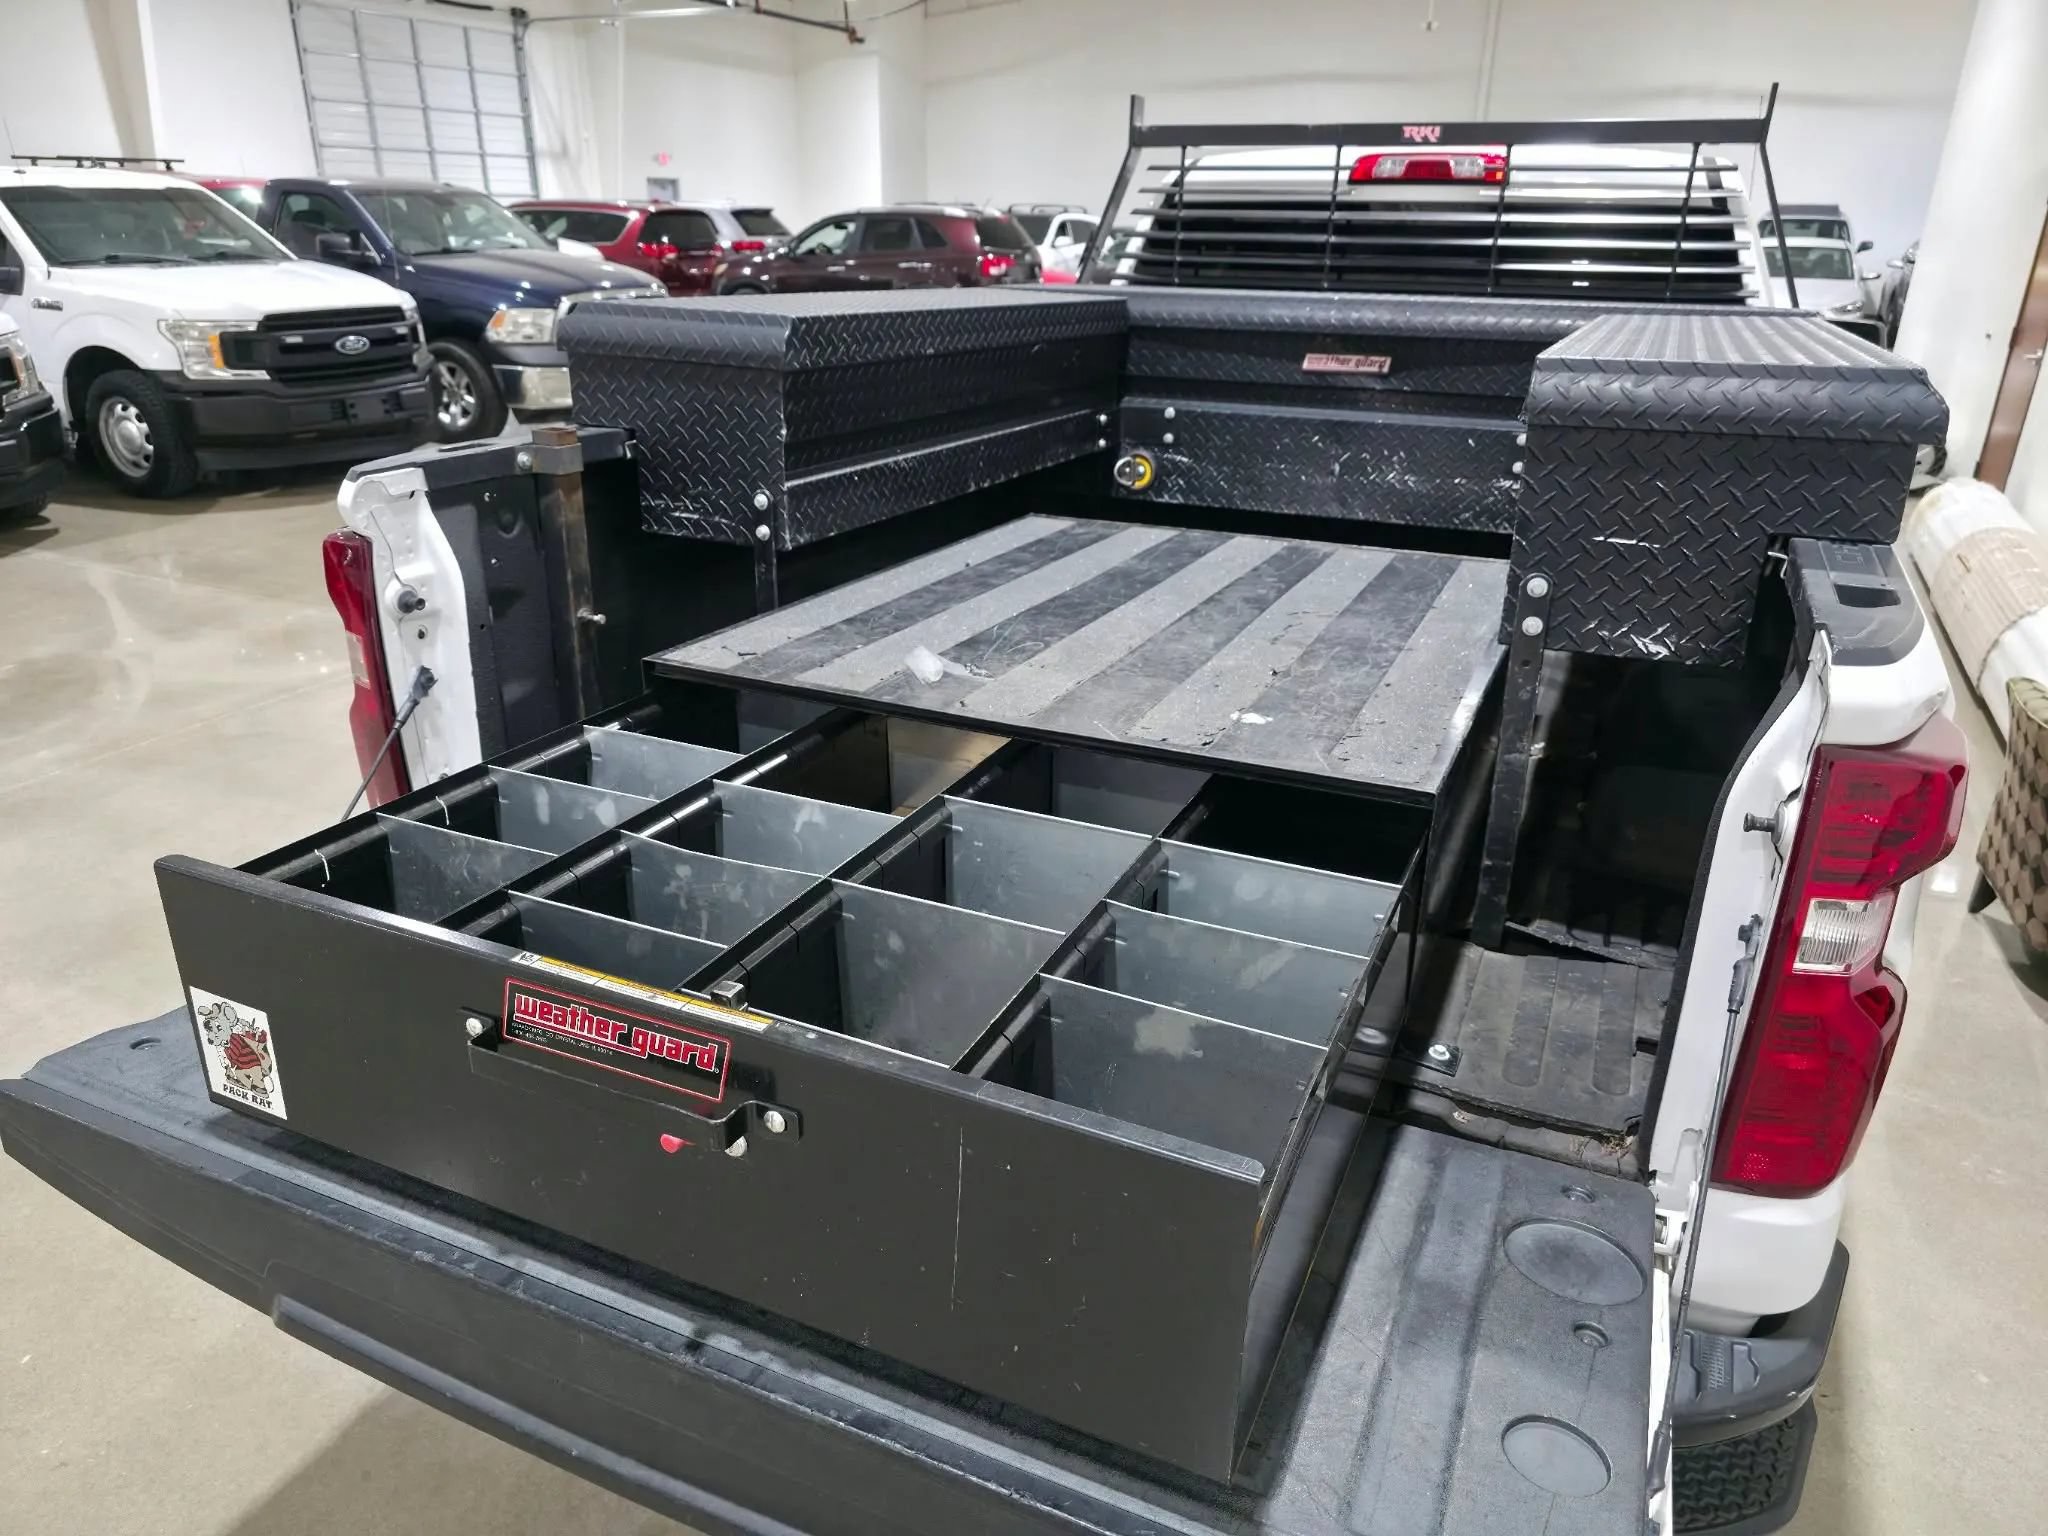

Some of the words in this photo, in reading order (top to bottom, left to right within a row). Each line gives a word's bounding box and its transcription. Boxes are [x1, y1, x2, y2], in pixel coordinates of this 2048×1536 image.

[514, 993, 627, 1043] weather
[632, 1027, 718, 1071] guard
[223, 1083, 249, 1101] PACK
[251, 1094, 273, 1109] RAT
